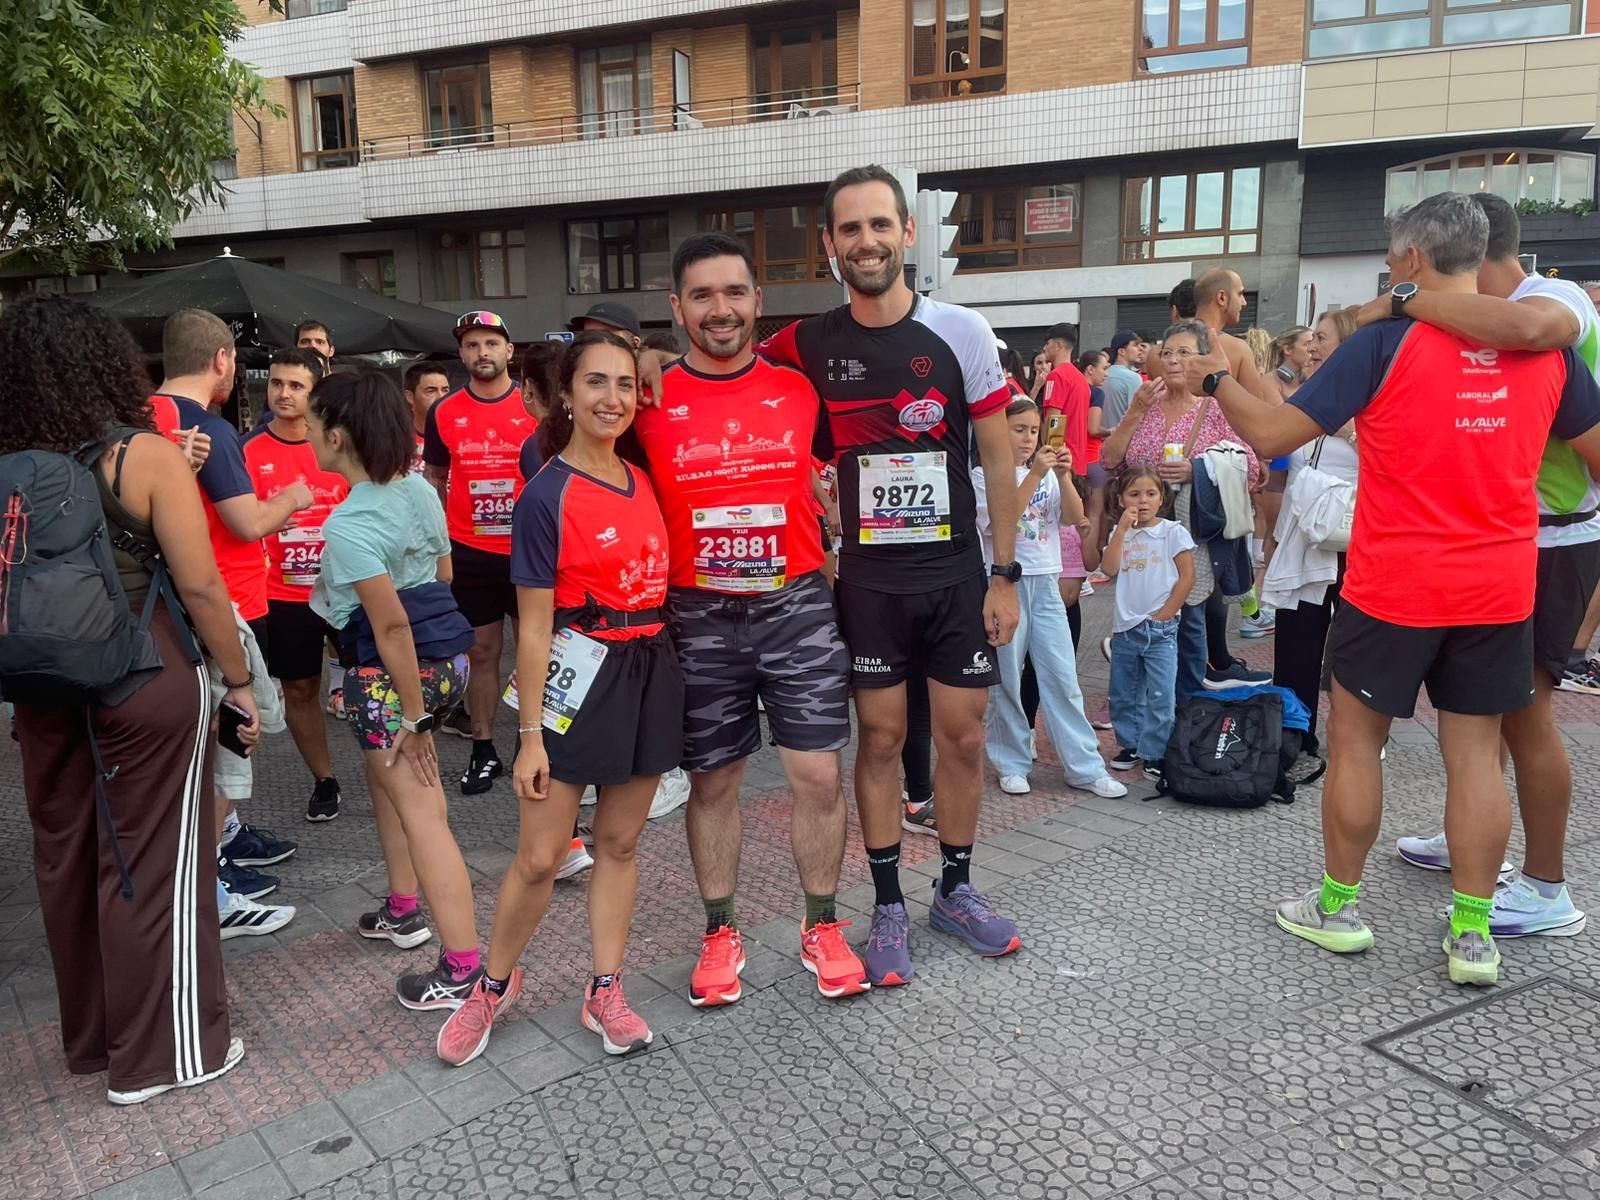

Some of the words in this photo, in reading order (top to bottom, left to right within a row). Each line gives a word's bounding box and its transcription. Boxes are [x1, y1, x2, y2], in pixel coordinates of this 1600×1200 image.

[714, 467, 739, 476] NIGHT
[740, 463, 776, 473] RUNNING
[777, 461, 797, 469] FEST
[872, 483, 935, 507] 9872
[699, 534, 777, 558] 23881
[855, 656, 882, 665] EIBAR
